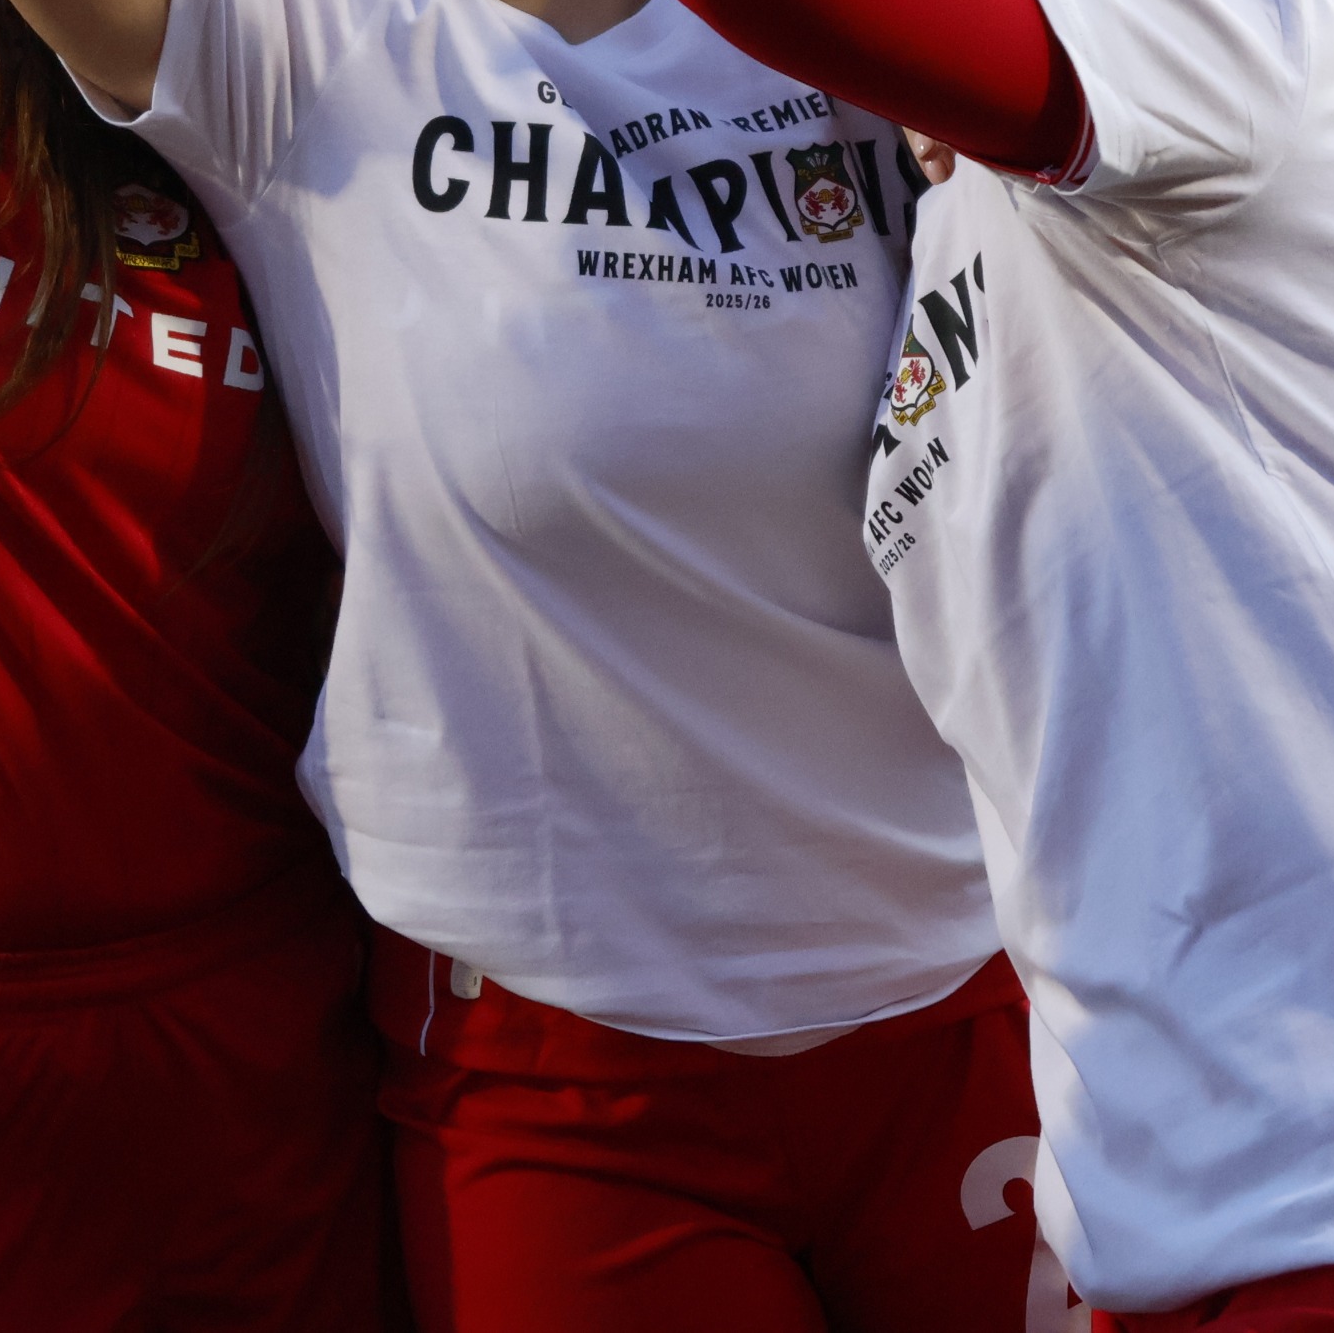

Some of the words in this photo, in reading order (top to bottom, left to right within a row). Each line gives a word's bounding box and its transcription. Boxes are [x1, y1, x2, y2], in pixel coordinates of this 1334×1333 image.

[609, 106, 712, 159] ADRAN
[720, 91, 836, 133] REMIE
[577, 249, 717, 284] WREXHAM
[730, 262, 774, 288] AFC
[779, 262, 858, 292] WOEN
[706, 293, 771, 310] 2025/26
[868, 500, 903, 546] AFC
[894, 436, 950, 507] WON
